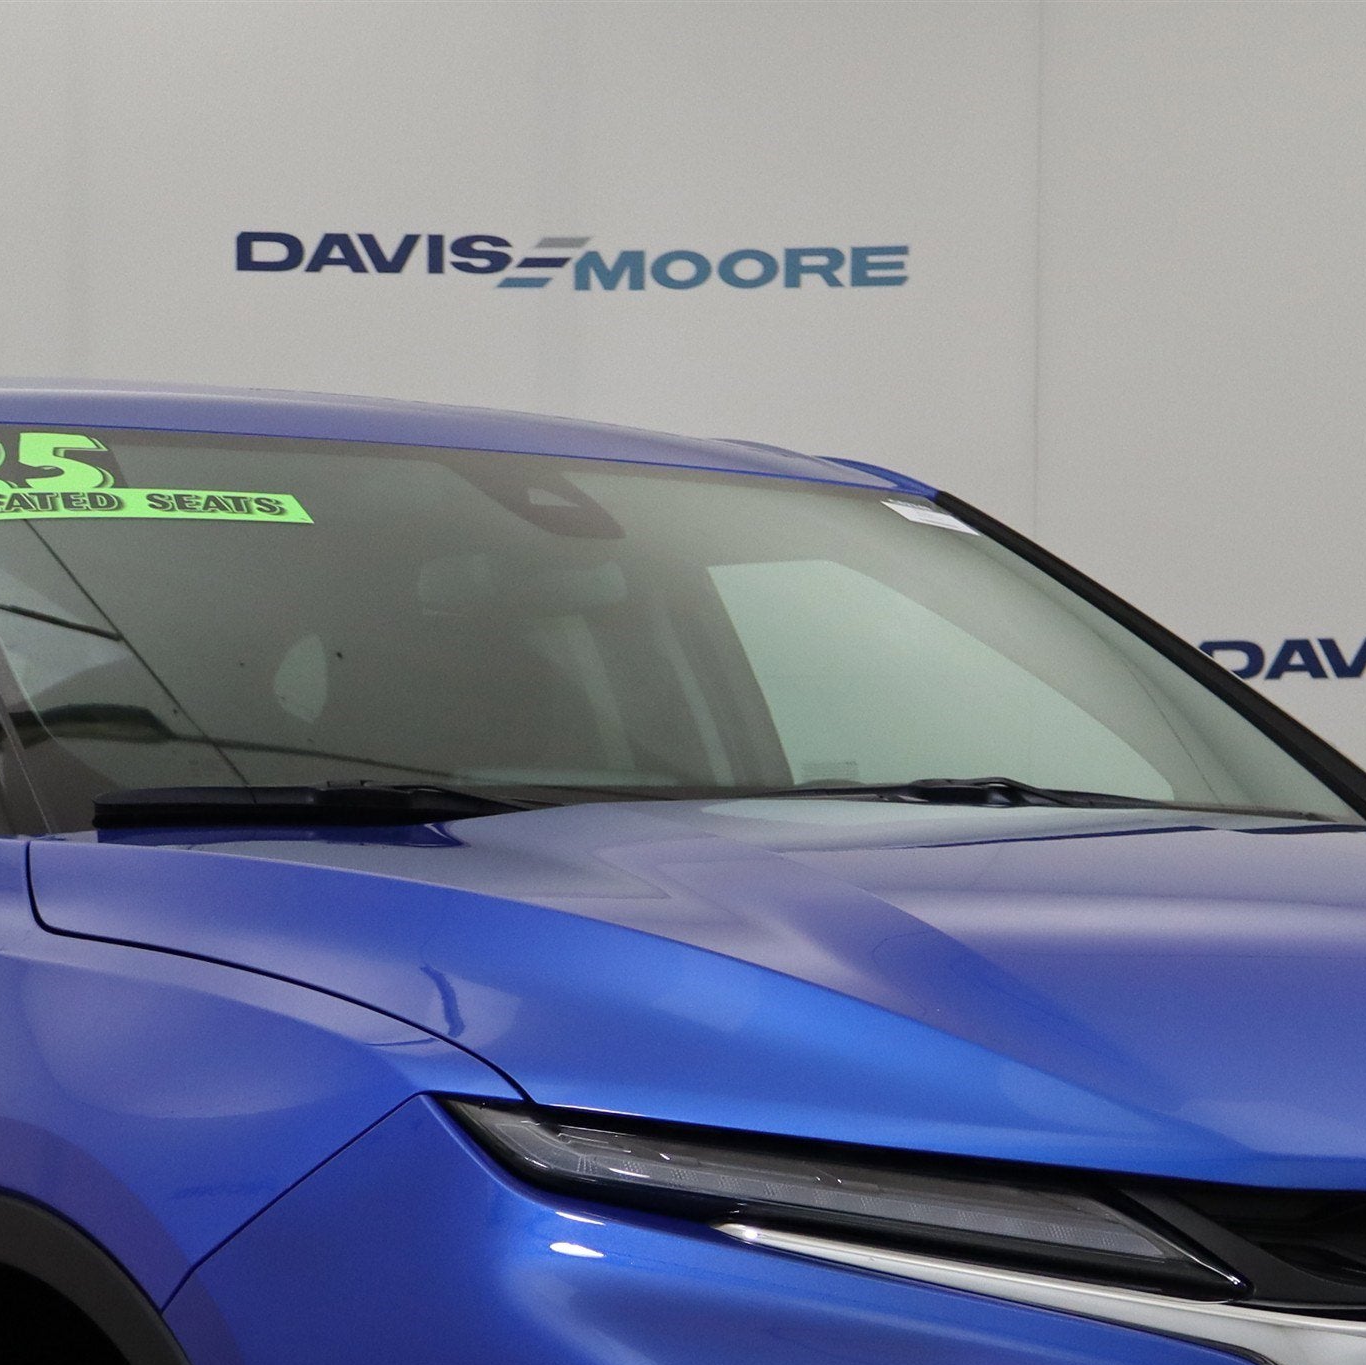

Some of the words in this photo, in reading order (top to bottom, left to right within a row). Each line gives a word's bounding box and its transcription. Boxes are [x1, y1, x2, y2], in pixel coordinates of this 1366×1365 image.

[235, 231, 514, 275] DAVIS
[573, 245, 910, 291] MOORE
[147, 492, 289, 516] SEATS
